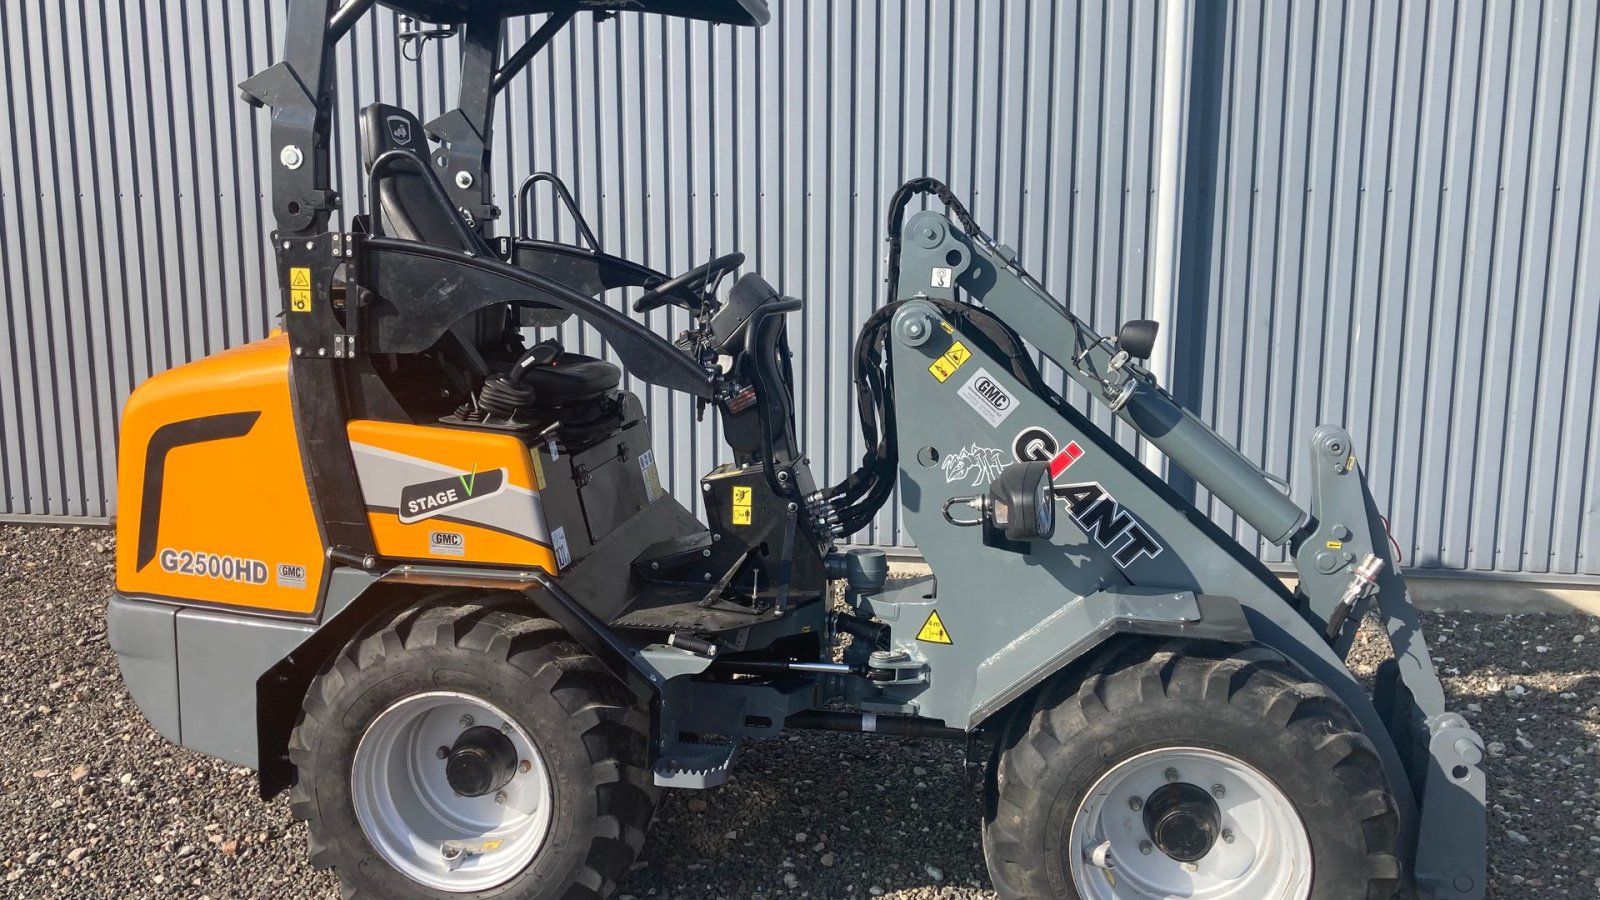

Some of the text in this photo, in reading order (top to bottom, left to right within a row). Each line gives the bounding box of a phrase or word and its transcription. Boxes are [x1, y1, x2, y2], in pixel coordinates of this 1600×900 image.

[978, 380, 1007, 407] GMC
[408, 489, 458, 513] STAGE
[436, 533, 458, 545] GMC
[160, 548, 268, 585] G2500HD
[282, 566, 301, 577] GMC
